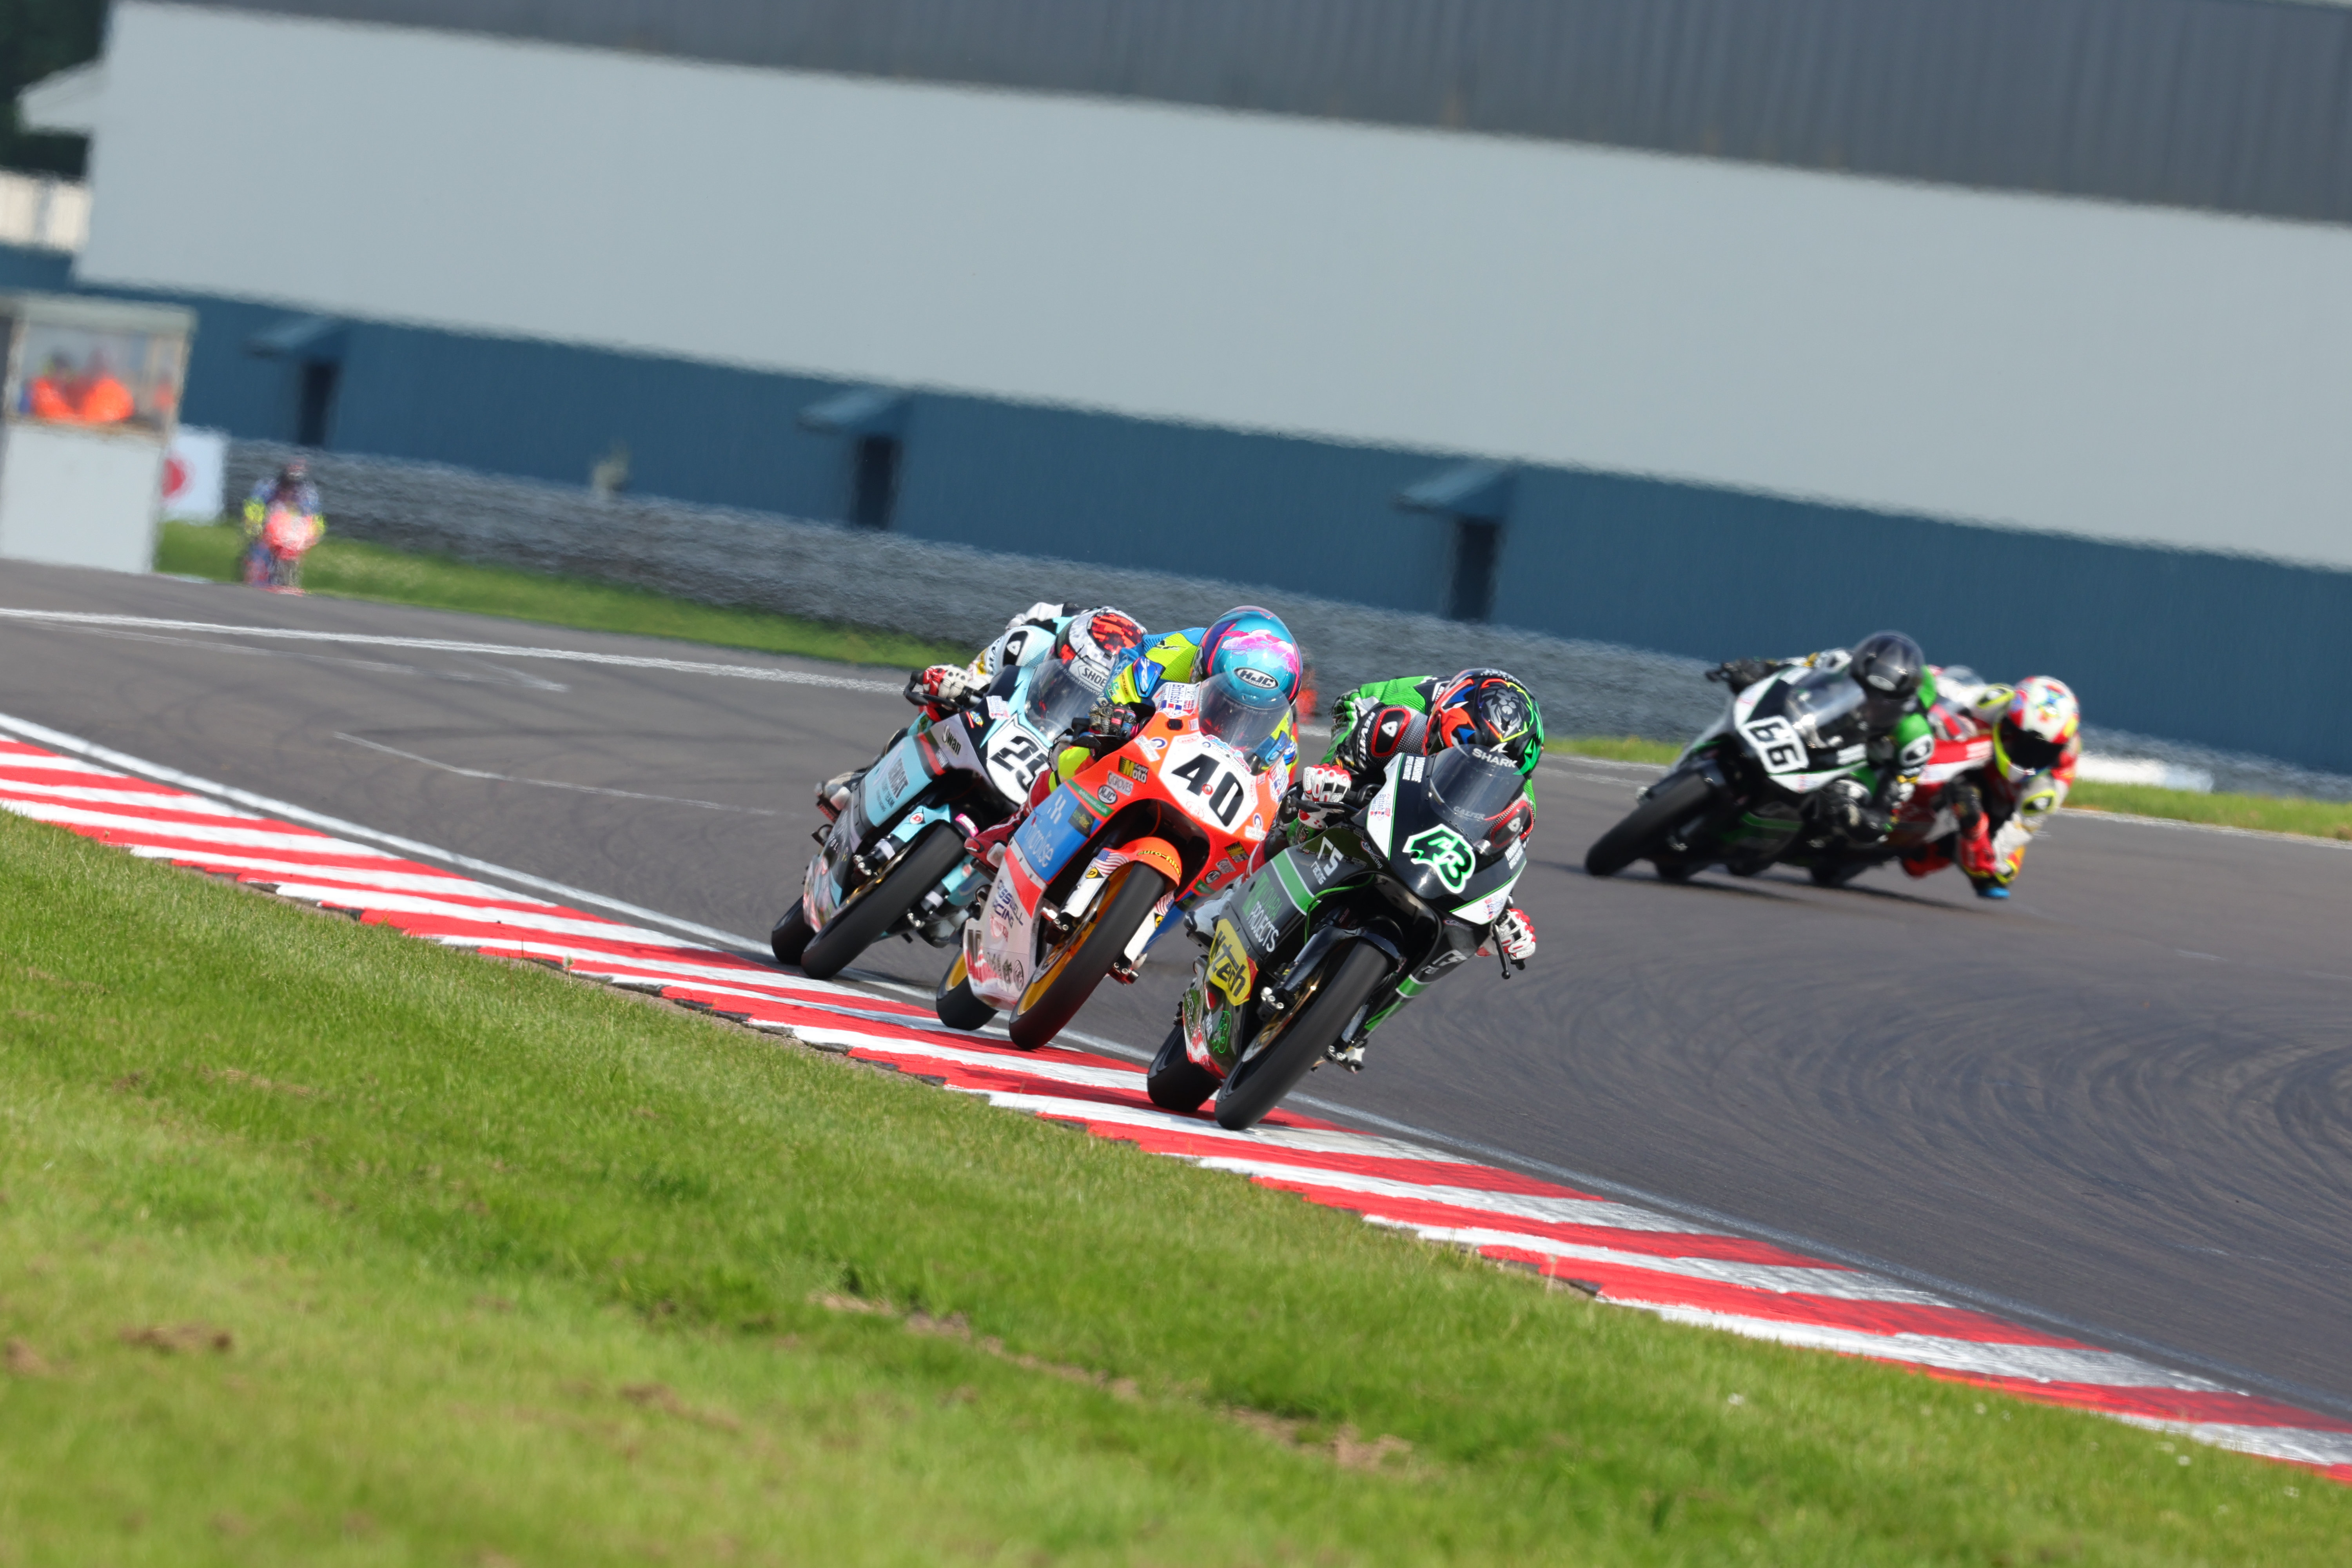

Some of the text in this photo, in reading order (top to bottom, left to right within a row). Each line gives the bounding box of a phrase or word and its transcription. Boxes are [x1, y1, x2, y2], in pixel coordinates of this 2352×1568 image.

[1082, 667, 1108, 686] SHOE
[1240, 670, 1276, 688] HJC
[1170, 684, 1184, 703] British
[1750, 718, 1800, 768] 66
[1411, 756, 1426, 783] YORKSHIRE
[1472, 748, 1518, 768] SHARK
[1171, 753, 1244, 827] 40
[1378, 793, 1386, 810] British
[1408, 828, 1473, 890] 43
[1247, 900, 1279, 953] PROJECTS
